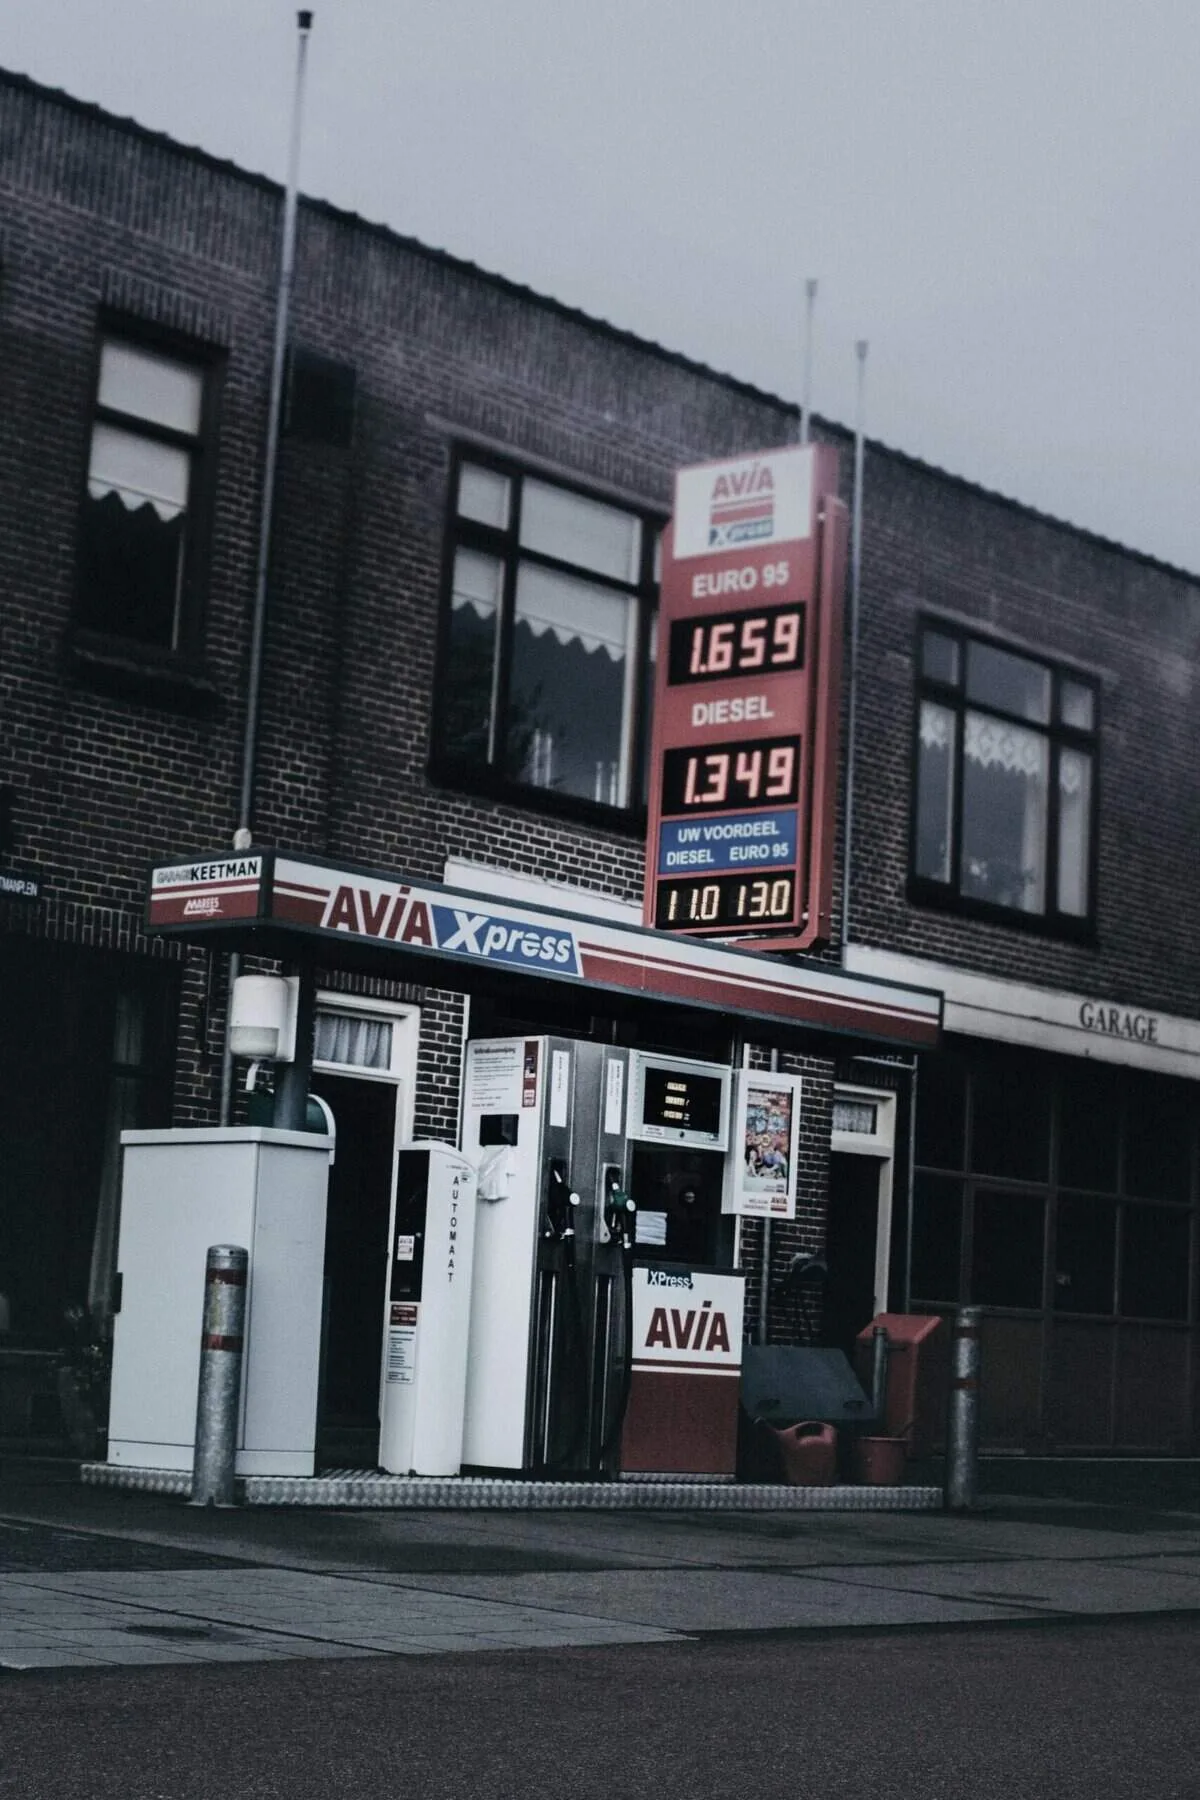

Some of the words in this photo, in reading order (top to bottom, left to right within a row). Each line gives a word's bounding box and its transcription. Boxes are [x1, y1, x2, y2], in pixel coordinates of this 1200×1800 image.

[692, 566, 758, 598] EURO
[762, 561, 790, 588] 95
[690, 613, 800, 674] 1.659
[691, 696, 775, 727] DIESEL
[684, 747, 795, 804] 1.349
[677, 828, 701, 844] UW
[703, 821, 780, 841] VOORDEEL
[191, 861, 258, 881] KEETMAN
[666, 849, 715, 866] DIESEL
[729, 844, 770, 862] EURO
[772, 842, 789, 858] 95
[737, 879, 791, 916] 13.0
[442, 911, 572, 963] Xpress
[1079, 1001, 1159, 1044] GARAGE
[448, 1175, 460, 1283] AUTOMAAT
[650, 1270, 691, 1288] XPress
